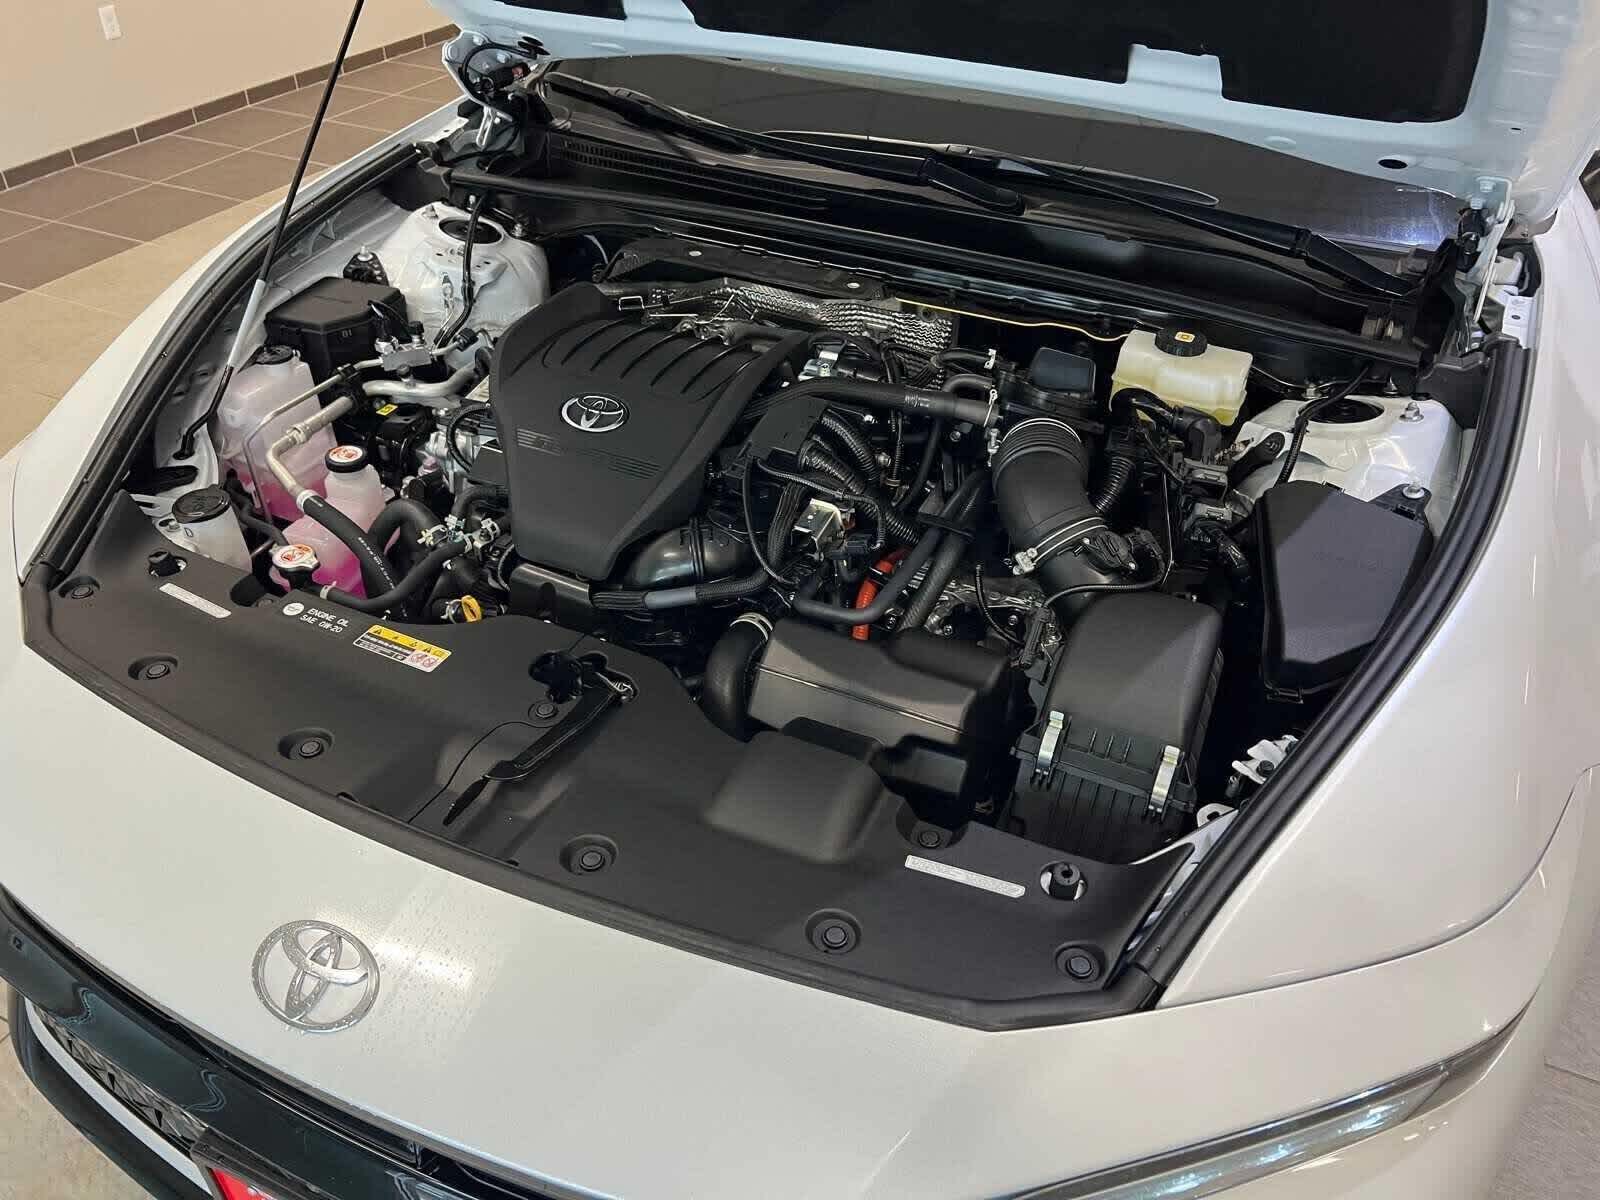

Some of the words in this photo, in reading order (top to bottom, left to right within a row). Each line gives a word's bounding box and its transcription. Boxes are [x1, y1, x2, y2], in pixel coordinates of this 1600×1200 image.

[300, 614, 319, 624] SAE
[318, 621, 344, 633] 0W-20
[307, 608, 337, 622] ENGINE
[337, 618, 349, 628] OIL
